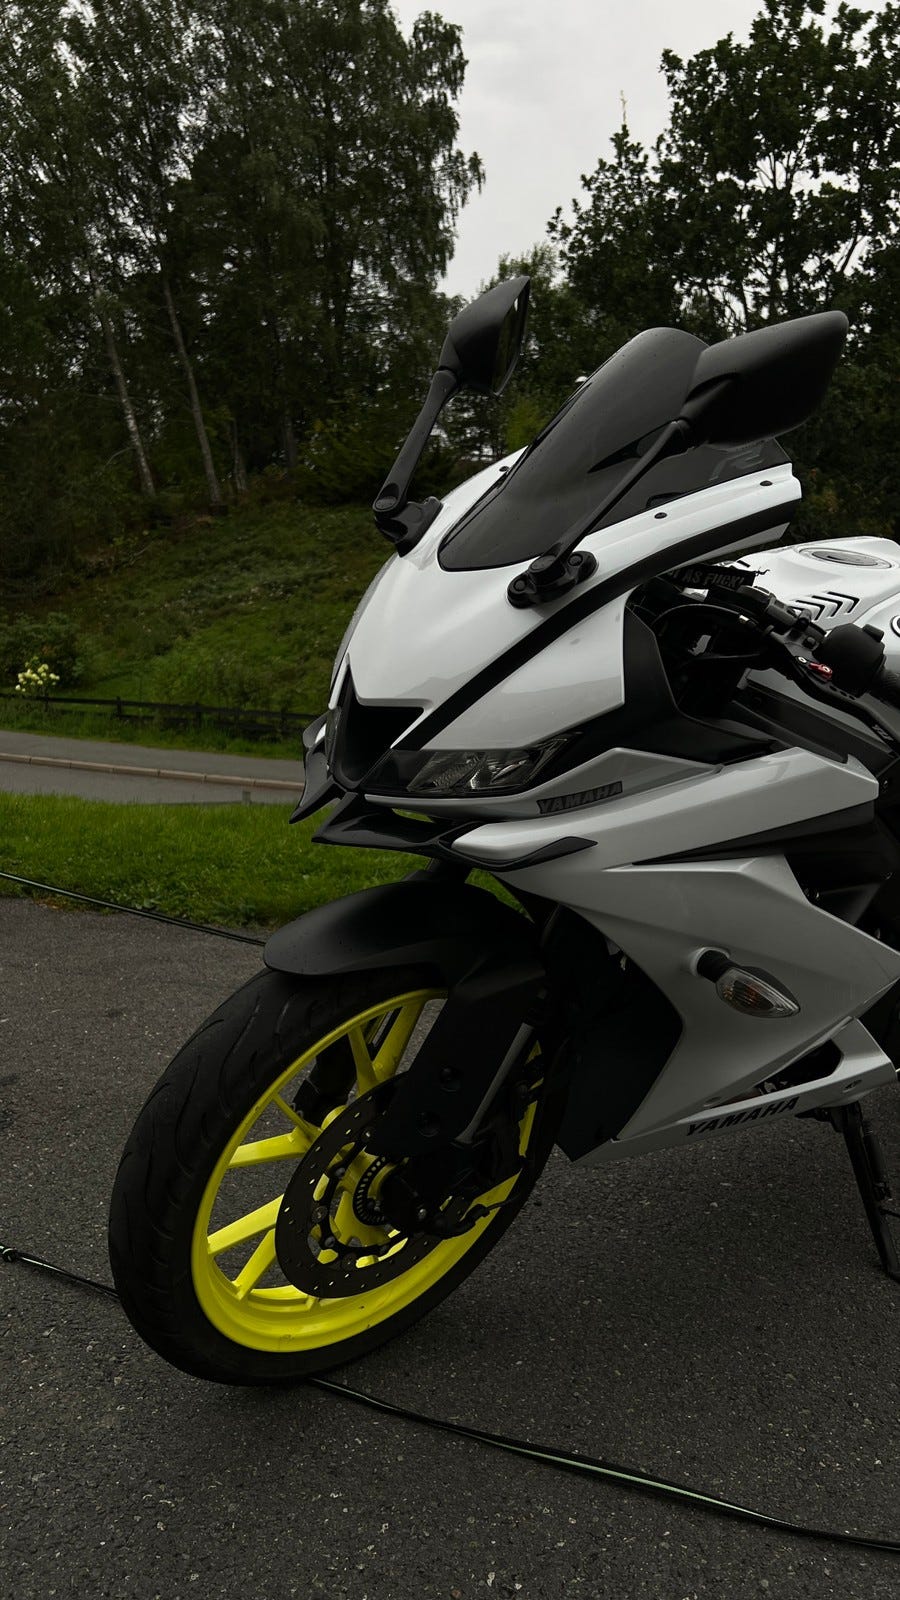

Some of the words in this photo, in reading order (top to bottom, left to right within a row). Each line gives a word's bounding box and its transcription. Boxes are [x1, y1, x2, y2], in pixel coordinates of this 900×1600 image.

[682, 569, 703, 584] AS
[538, 782, 622, 813] YAMAHA
[687, 1096, 800, 1136] YAMAHA
